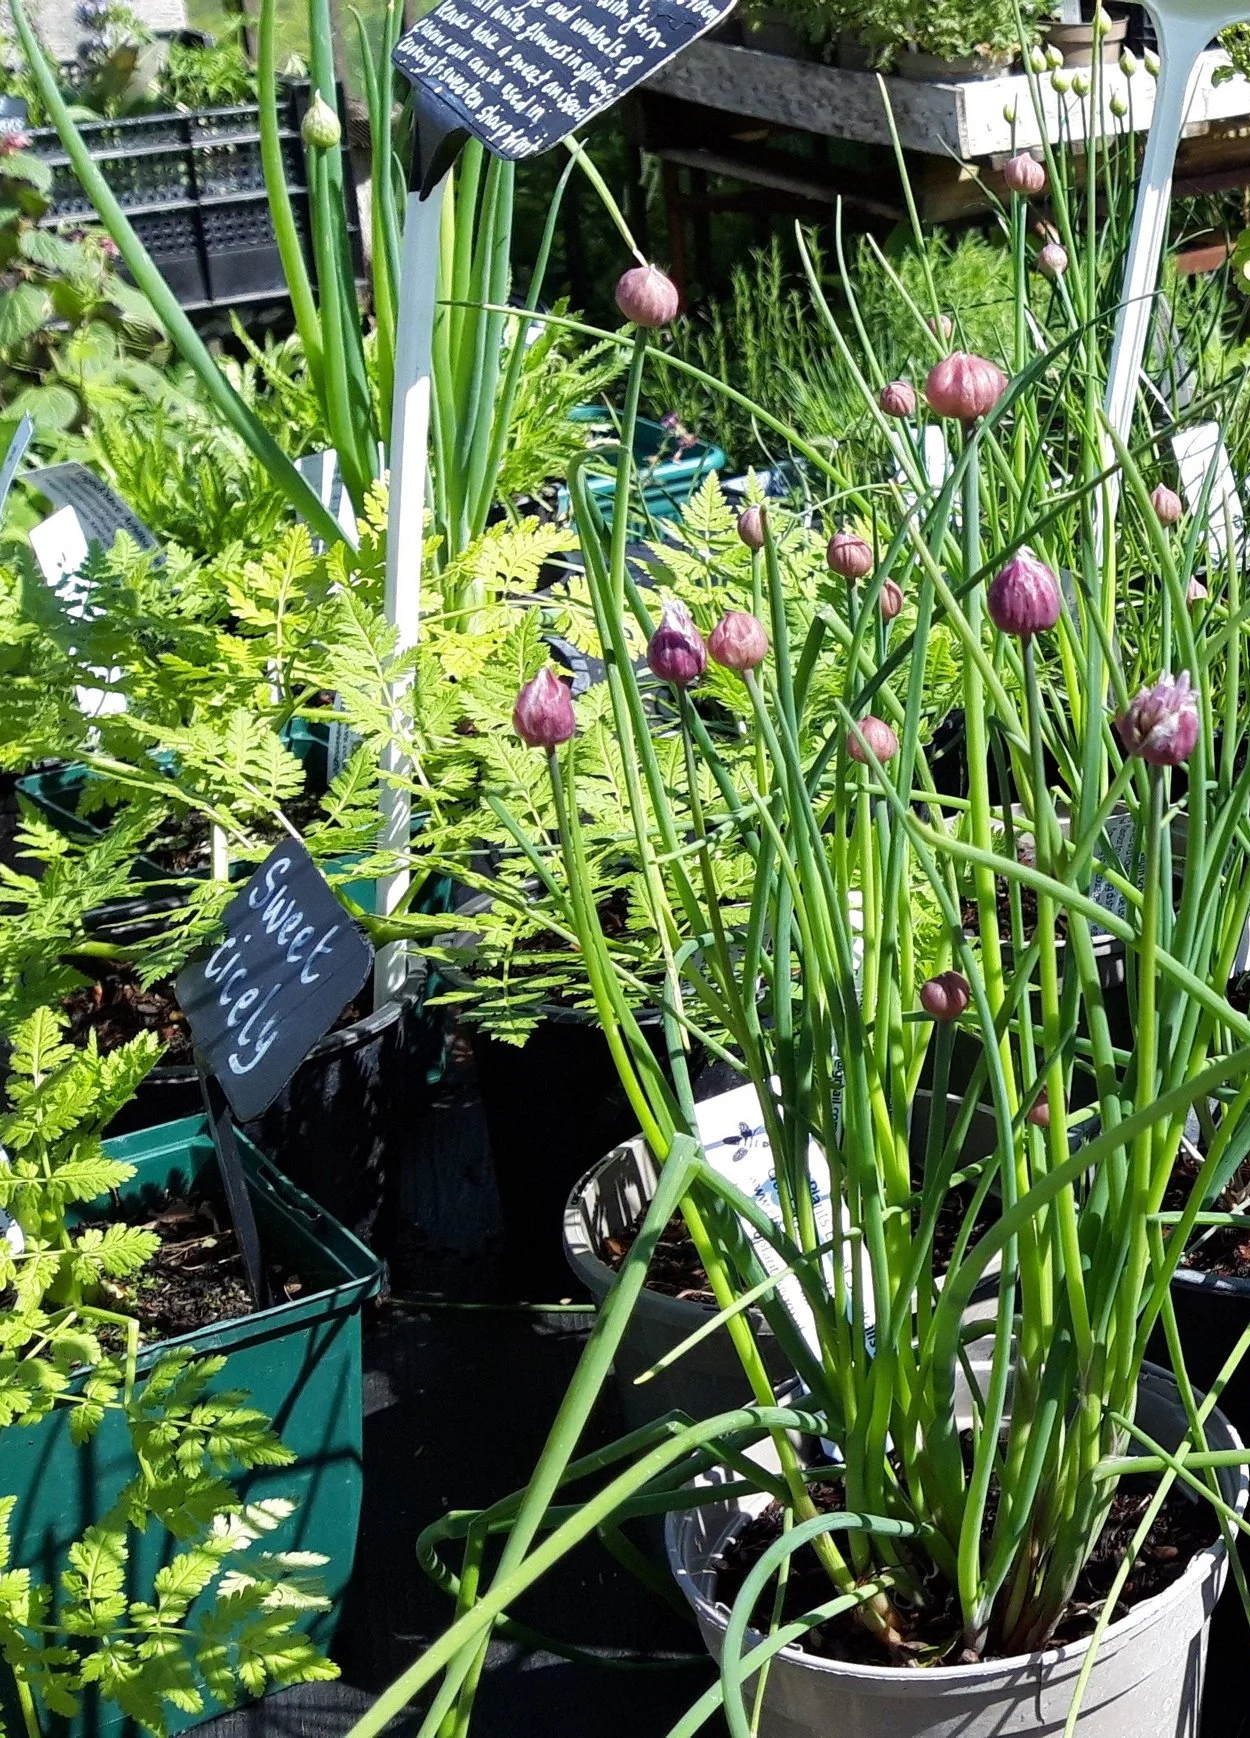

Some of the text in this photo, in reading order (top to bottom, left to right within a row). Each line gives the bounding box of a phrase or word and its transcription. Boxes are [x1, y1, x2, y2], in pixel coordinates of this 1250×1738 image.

[405, 18, 546, 124] flavour and can be used in
[470, 19, 500, 50] have
[504, 53, 553, 87] sweet
[541, 81, 601, 122] aniseed
[489, 4, 526, 32] white
[515, 22, 573, 60] flowers
[545, 1, 582, 23] and
[569, 17, 627, 58] umbels
[613, 55, 644, 80] of
[397, 36, 438, 74] cooking
[438, 67, 485, 111] sweeten
[474, 104, 513, 142] sharp
[249, 857, 339, 984] Sweet
